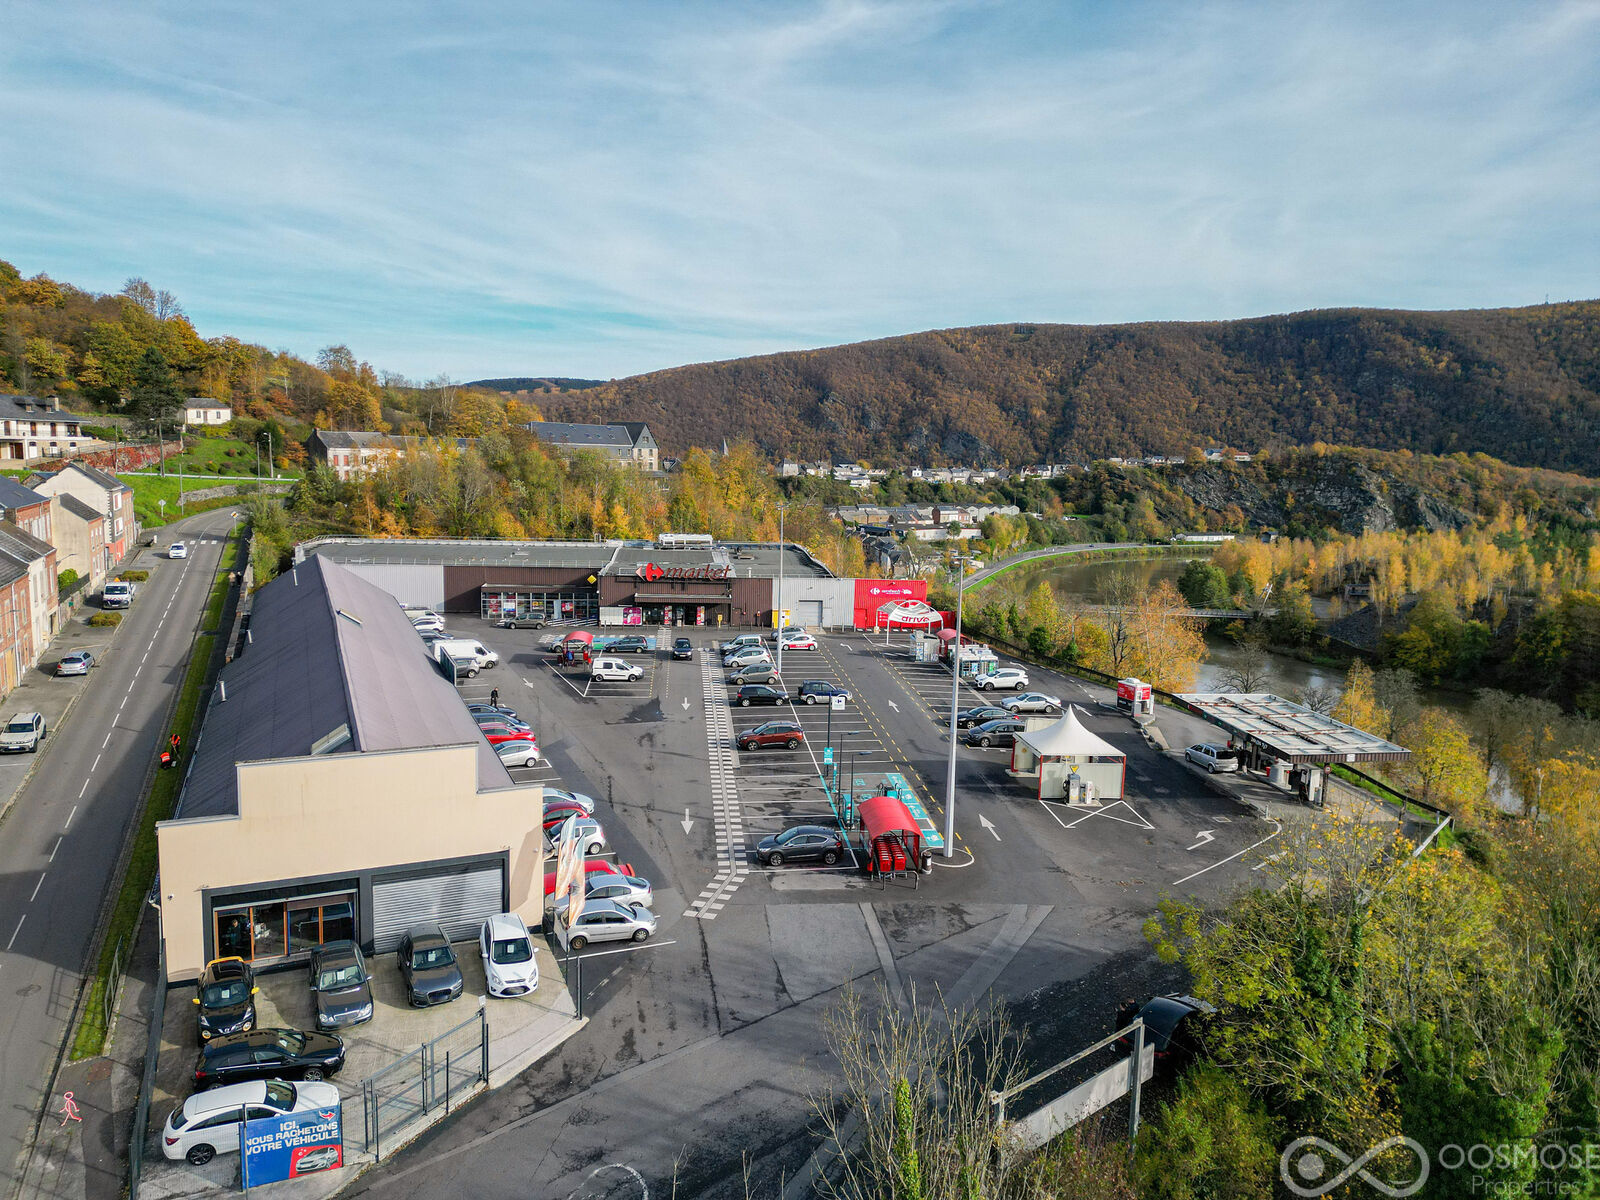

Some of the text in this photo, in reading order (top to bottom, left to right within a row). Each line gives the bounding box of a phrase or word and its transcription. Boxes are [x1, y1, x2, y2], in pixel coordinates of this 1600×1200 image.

[664, 564, 732, 581] market
[901, 615, 930, 623] drive
[246, 1121, 338, 1146] NOUS RACHETONS
[246, 1140, 283, 1156] VOTRE
